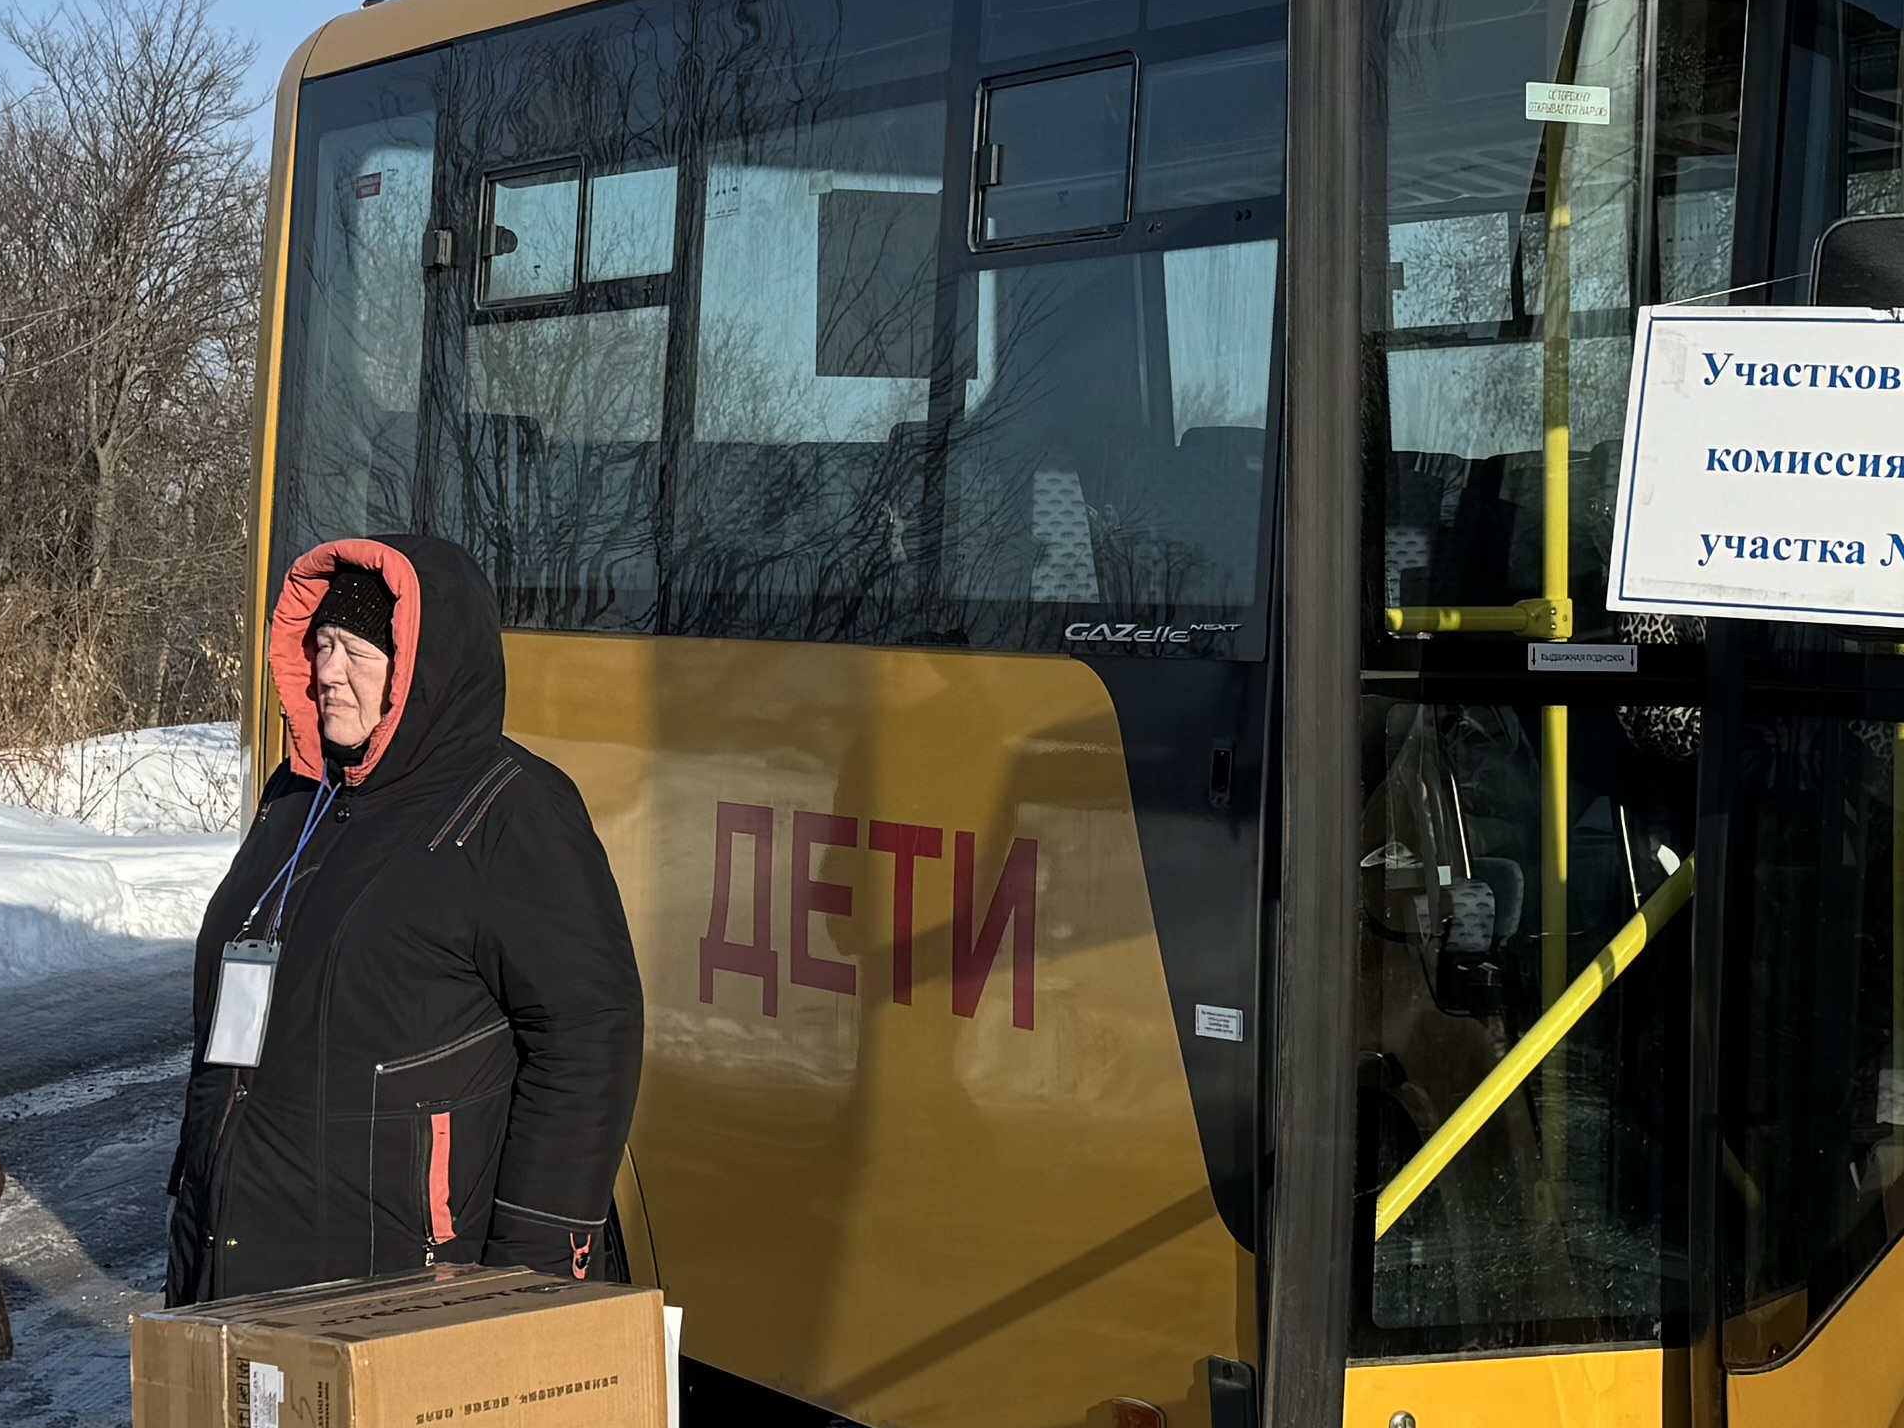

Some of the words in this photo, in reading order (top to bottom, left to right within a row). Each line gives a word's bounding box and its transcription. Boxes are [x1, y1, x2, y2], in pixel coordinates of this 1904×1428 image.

[1697, 533, 1866, 568] участка
[1064, 622, 1191, 643] GAZelle
[1190, 623, 1244, 632] NEXT
[699, 801, 1039, 1031] ДЕТИ
